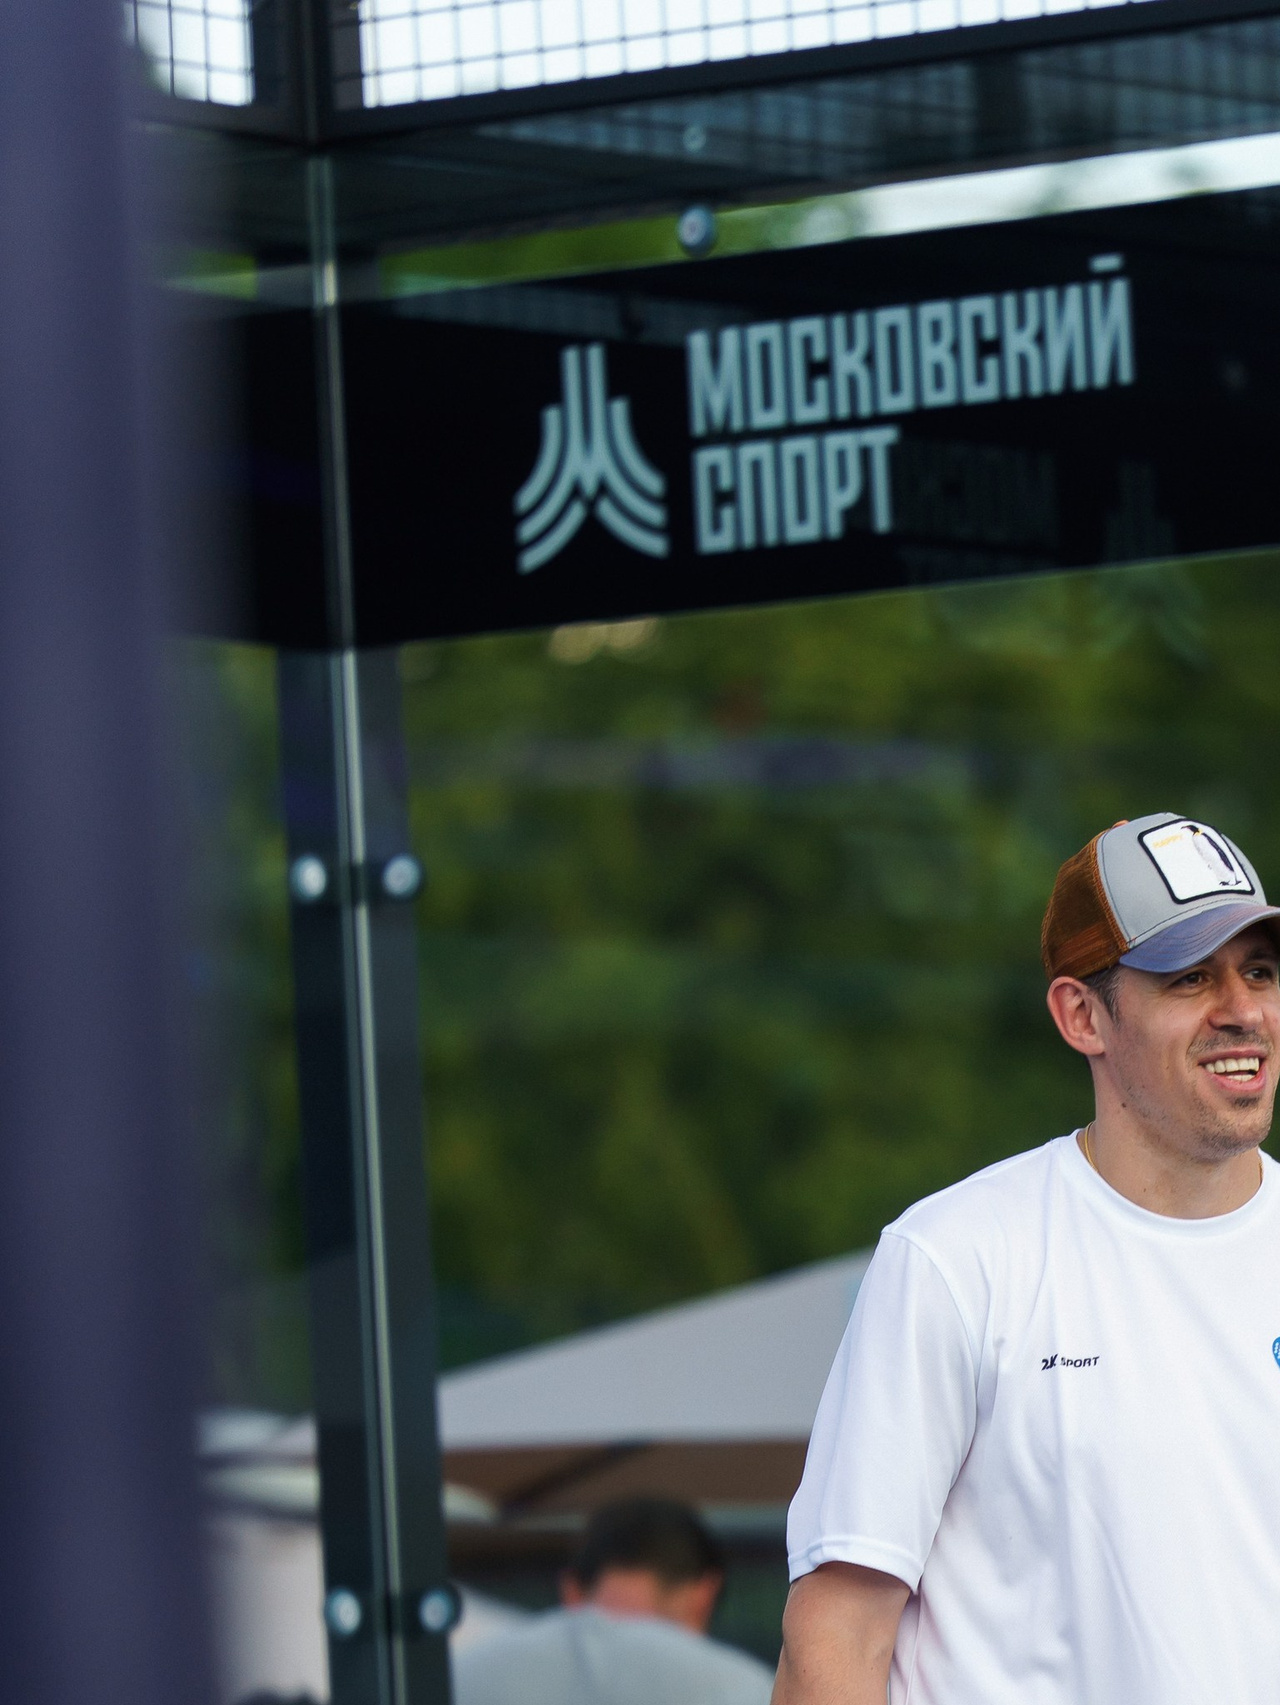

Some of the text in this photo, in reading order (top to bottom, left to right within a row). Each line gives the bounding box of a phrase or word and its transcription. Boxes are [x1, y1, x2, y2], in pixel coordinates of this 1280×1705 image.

[687, 253, 1136, 438] МОСКОВСКИЙ
[692, 424, 901, 555] СПОРТ
[1060, 1355, 1100, 1368] SPORT
